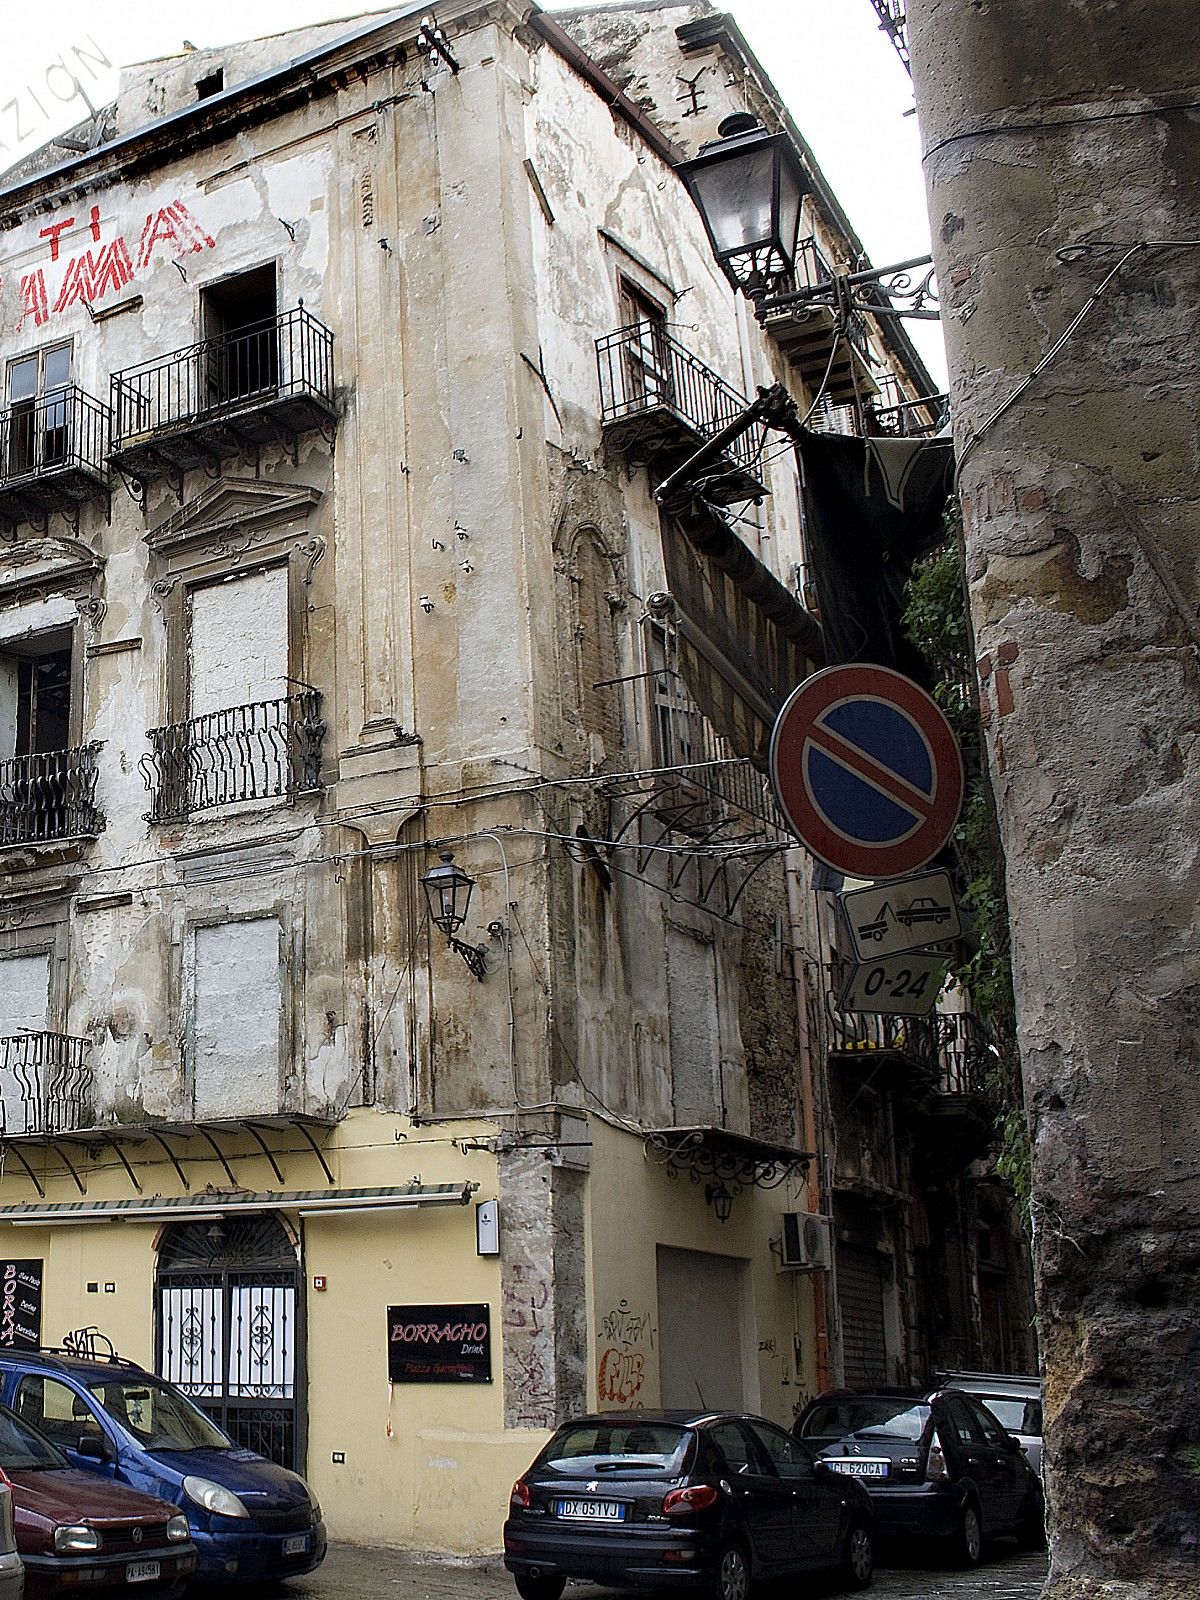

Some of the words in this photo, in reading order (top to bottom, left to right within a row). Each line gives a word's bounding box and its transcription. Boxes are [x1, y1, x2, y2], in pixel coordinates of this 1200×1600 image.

[864, 967, 931, 999] 0-24
[0, 1264, 17, 1346] BORRA
[391, 1323, 487, 1343] BORRACHO
[461, 1344, 484, 1356] Drink
[565, 1502, 578, 1515] DX
[582, 1503, 618, 1517] 051VJ
